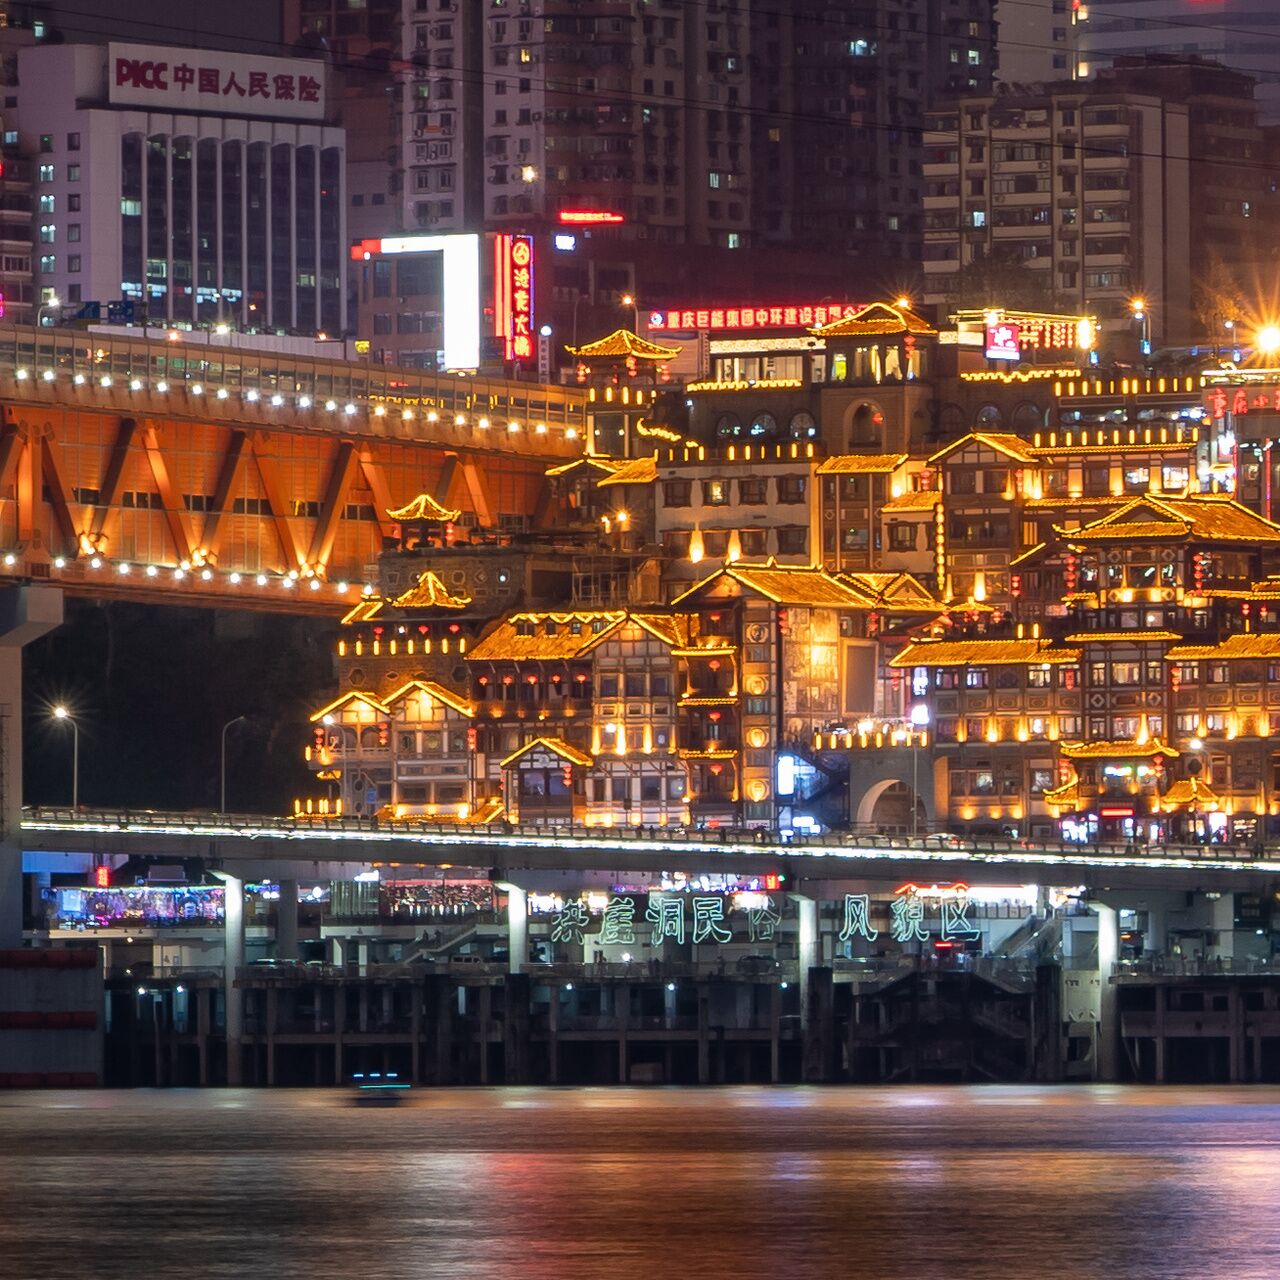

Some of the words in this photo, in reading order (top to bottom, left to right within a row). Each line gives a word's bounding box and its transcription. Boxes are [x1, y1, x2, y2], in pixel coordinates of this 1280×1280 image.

[115, 58, 168, 90] PICC
[173, 63, 321, 102] 中国人民保险
[667, 304, 869, 328] 重庆巨能集团中环建设有限公
